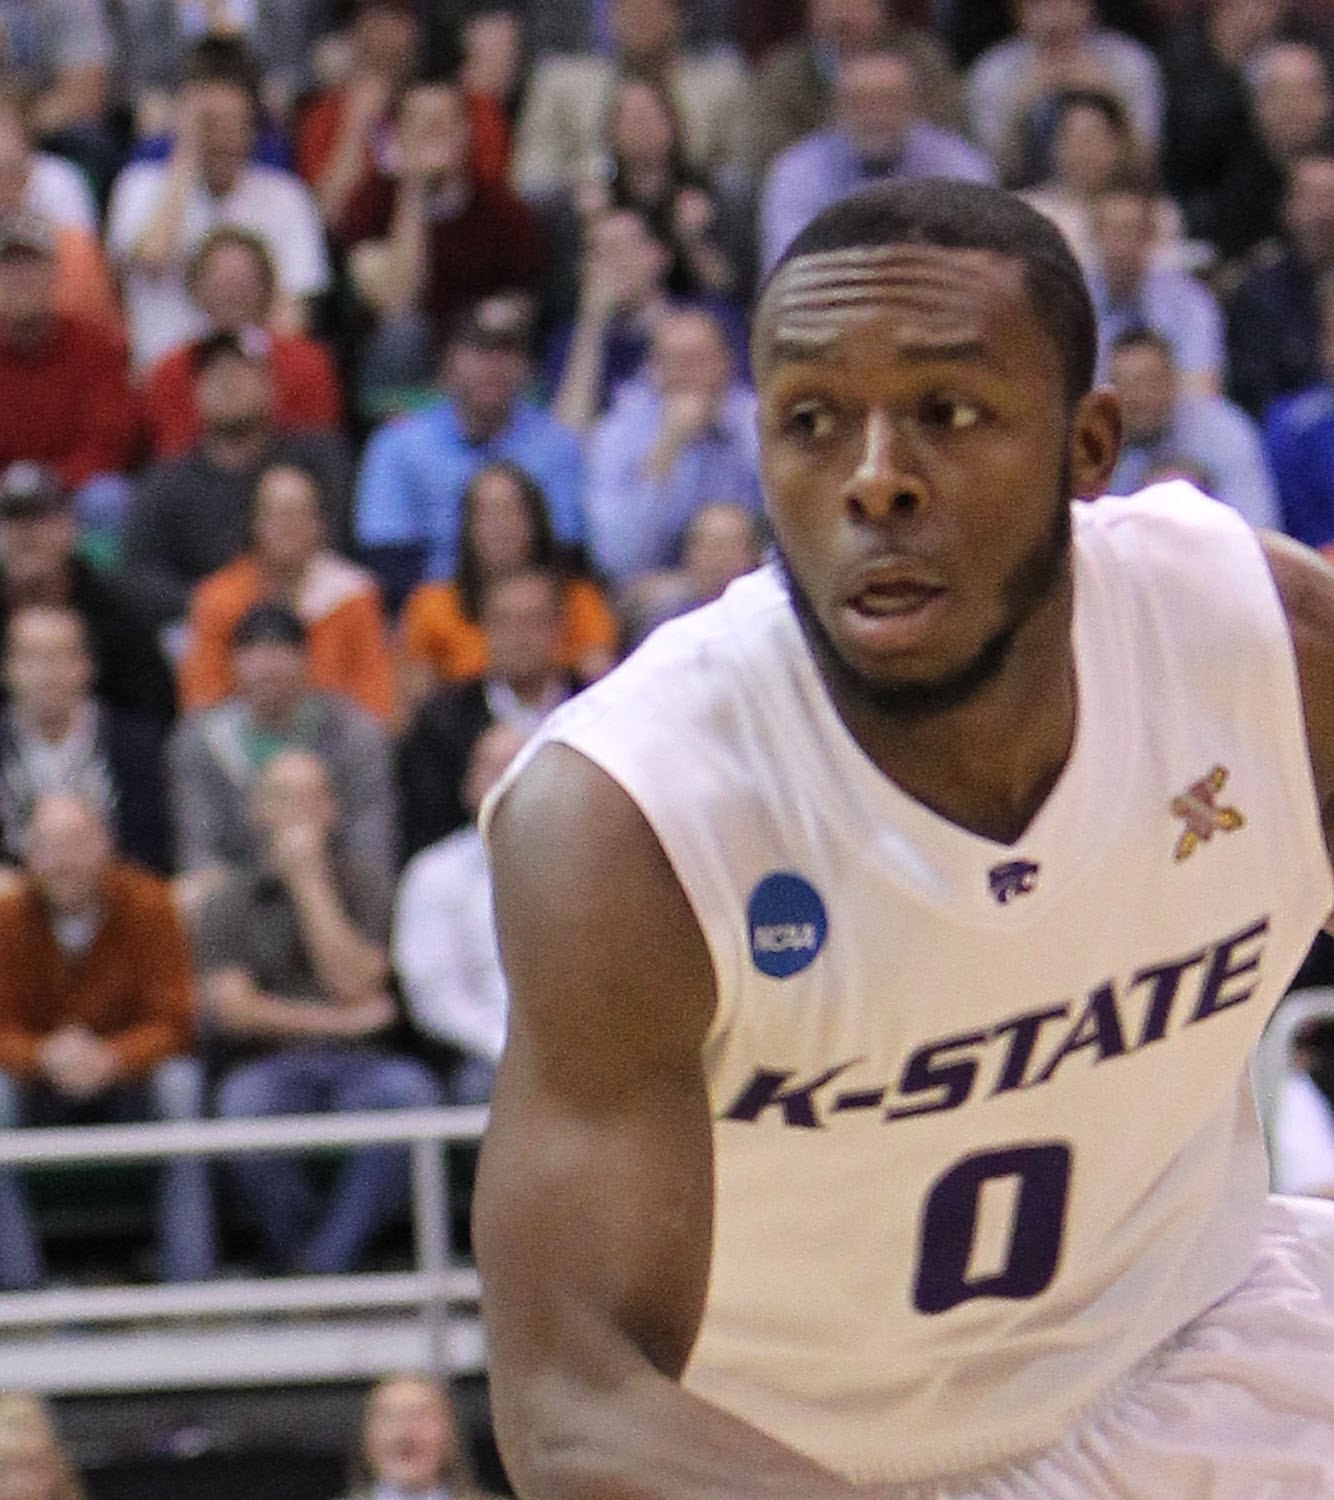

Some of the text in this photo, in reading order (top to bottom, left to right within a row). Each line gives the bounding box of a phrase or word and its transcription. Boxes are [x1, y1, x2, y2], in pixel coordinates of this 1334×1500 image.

[718, 916, 1270, 1130] K-STATE
[752, 922, 818, 954] NCAA
[909, 1138, 1075, 1316] 0
